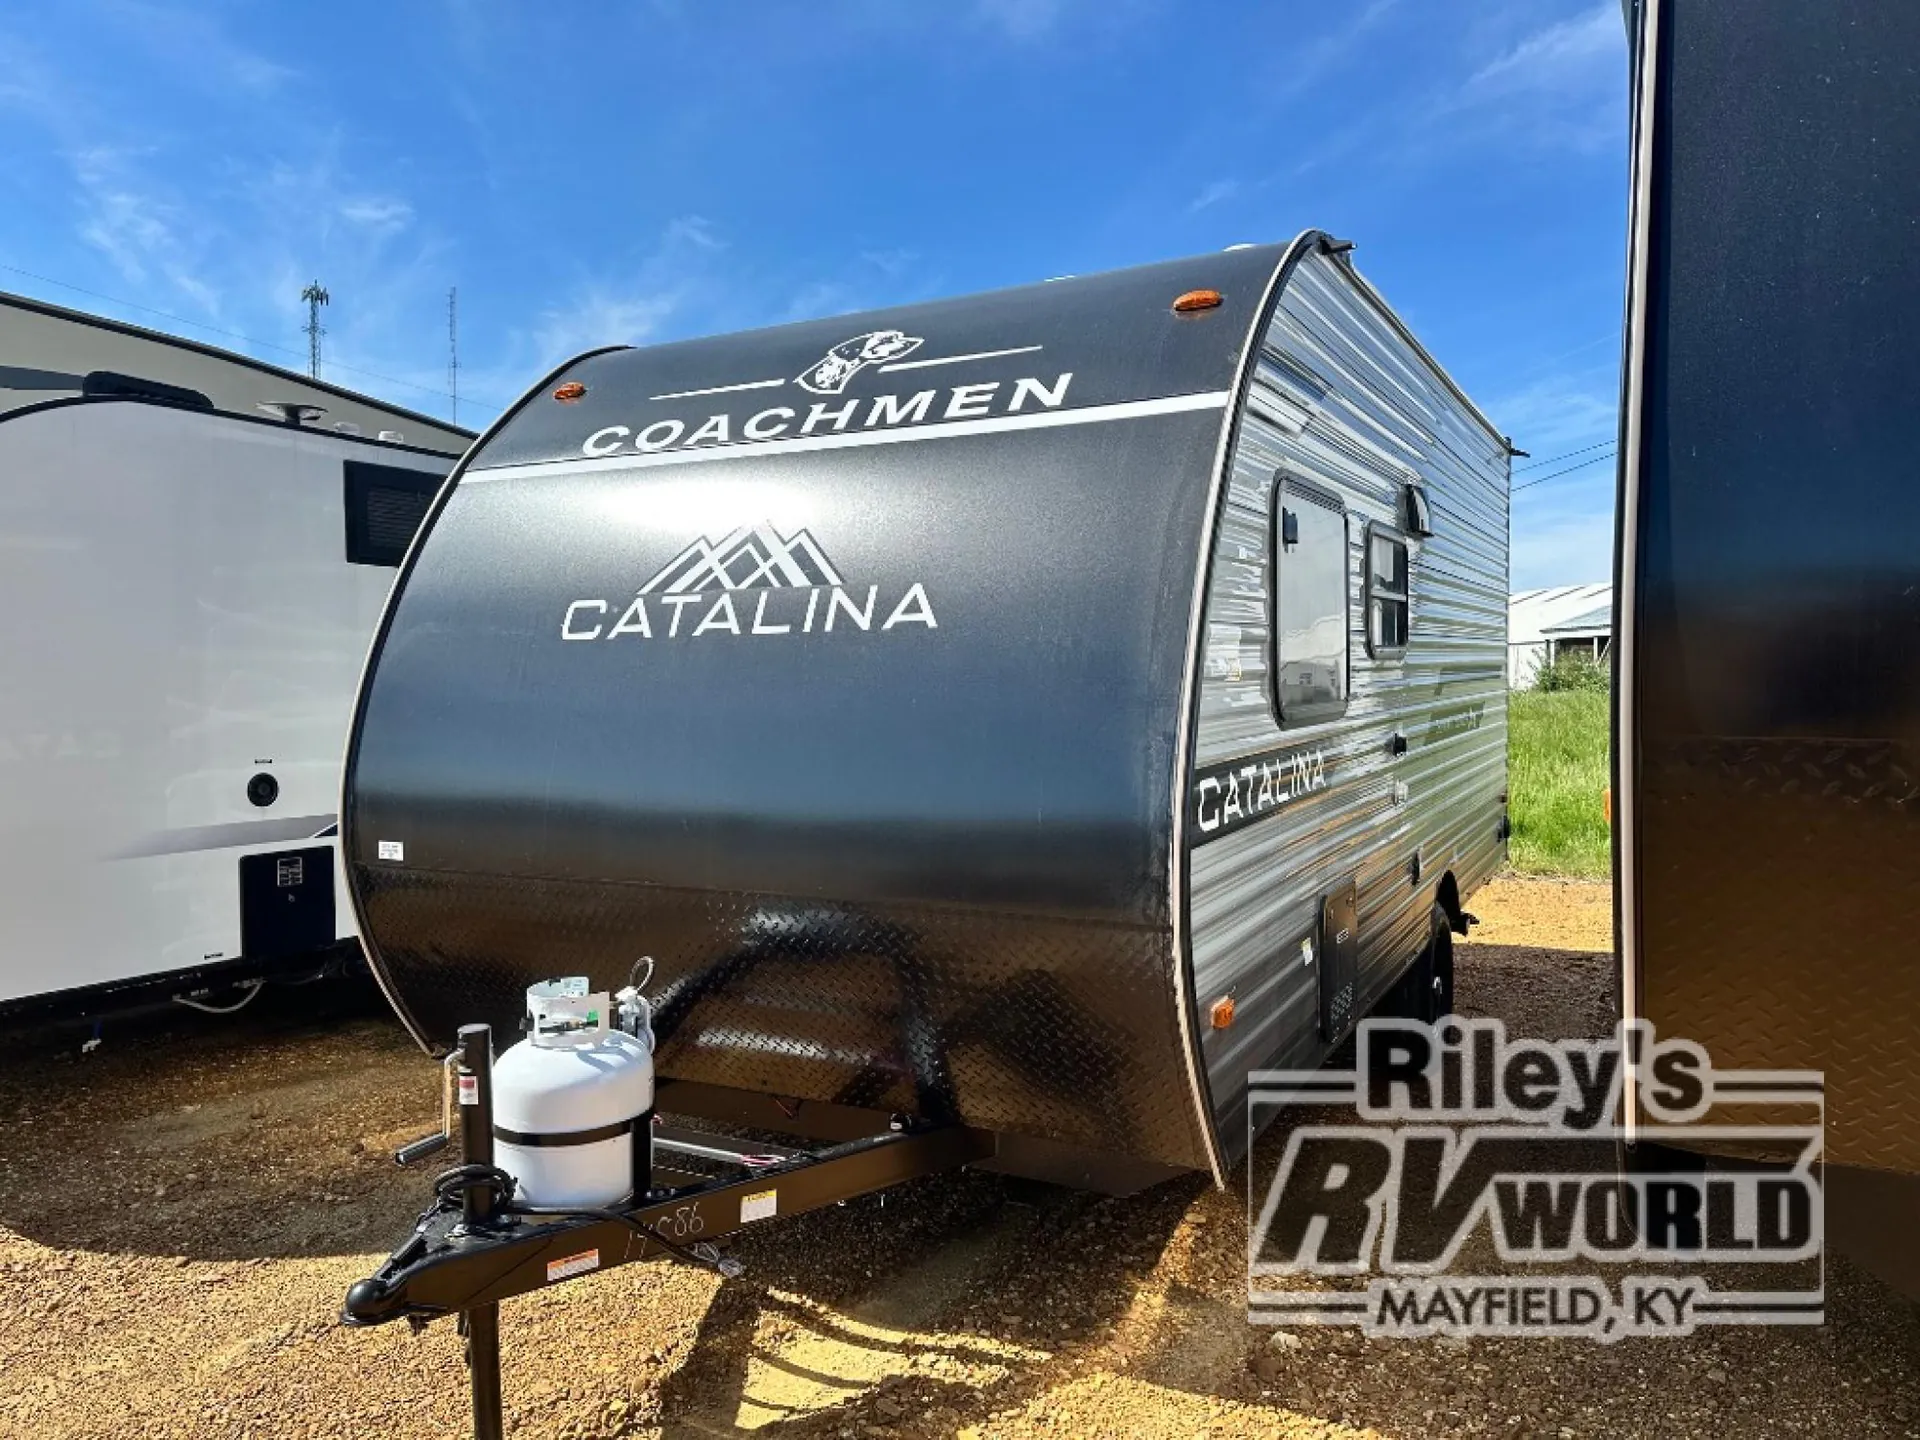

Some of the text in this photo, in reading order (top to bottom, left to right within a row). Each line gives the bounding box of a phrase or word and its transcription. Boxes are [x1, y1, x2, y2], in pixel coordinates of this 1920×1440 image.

[582, 372, 1074, 457] COACHMEN
[560, 582, 938, 640] CATALINA
[1198, 749, 1327, 832] CATALINA
